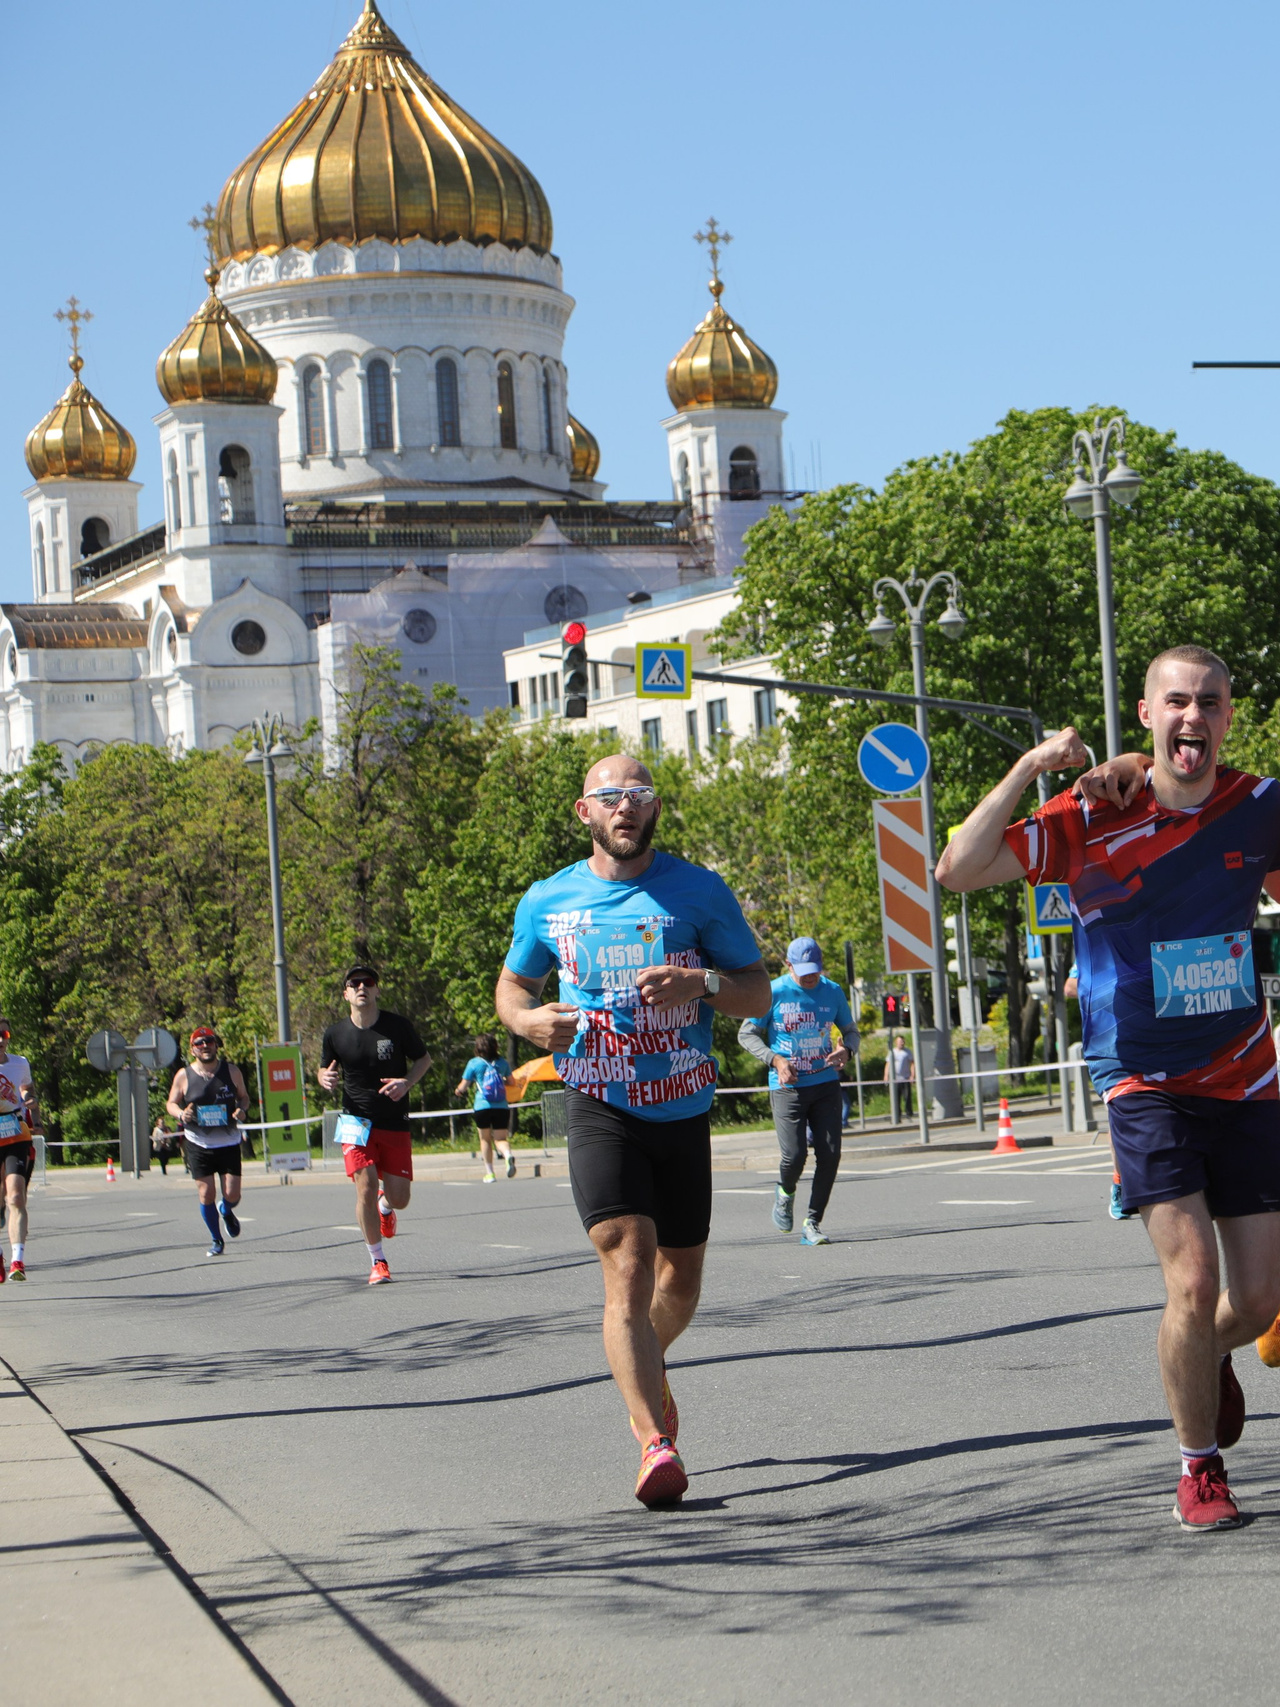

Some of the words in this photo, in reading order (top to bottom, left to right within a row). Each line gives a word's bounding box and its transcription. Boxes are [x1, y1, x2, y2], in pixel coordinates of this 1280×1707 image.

[546, 909, 593, 938] 2024
[595, 944, 645, 968] 41519
[1173, 958, 1237, 991] 40526
[779, 1002, 801, 1014] 2024
[1184, 989, 1232, 1016] 21.1KM
[783, 1011, 816, 1024] #МЕЧТА
[556, 1056, 636, 1082] #ЛЮБОВЬ
[627, 1060, 716, 1107] #ЕДИНСТВО
